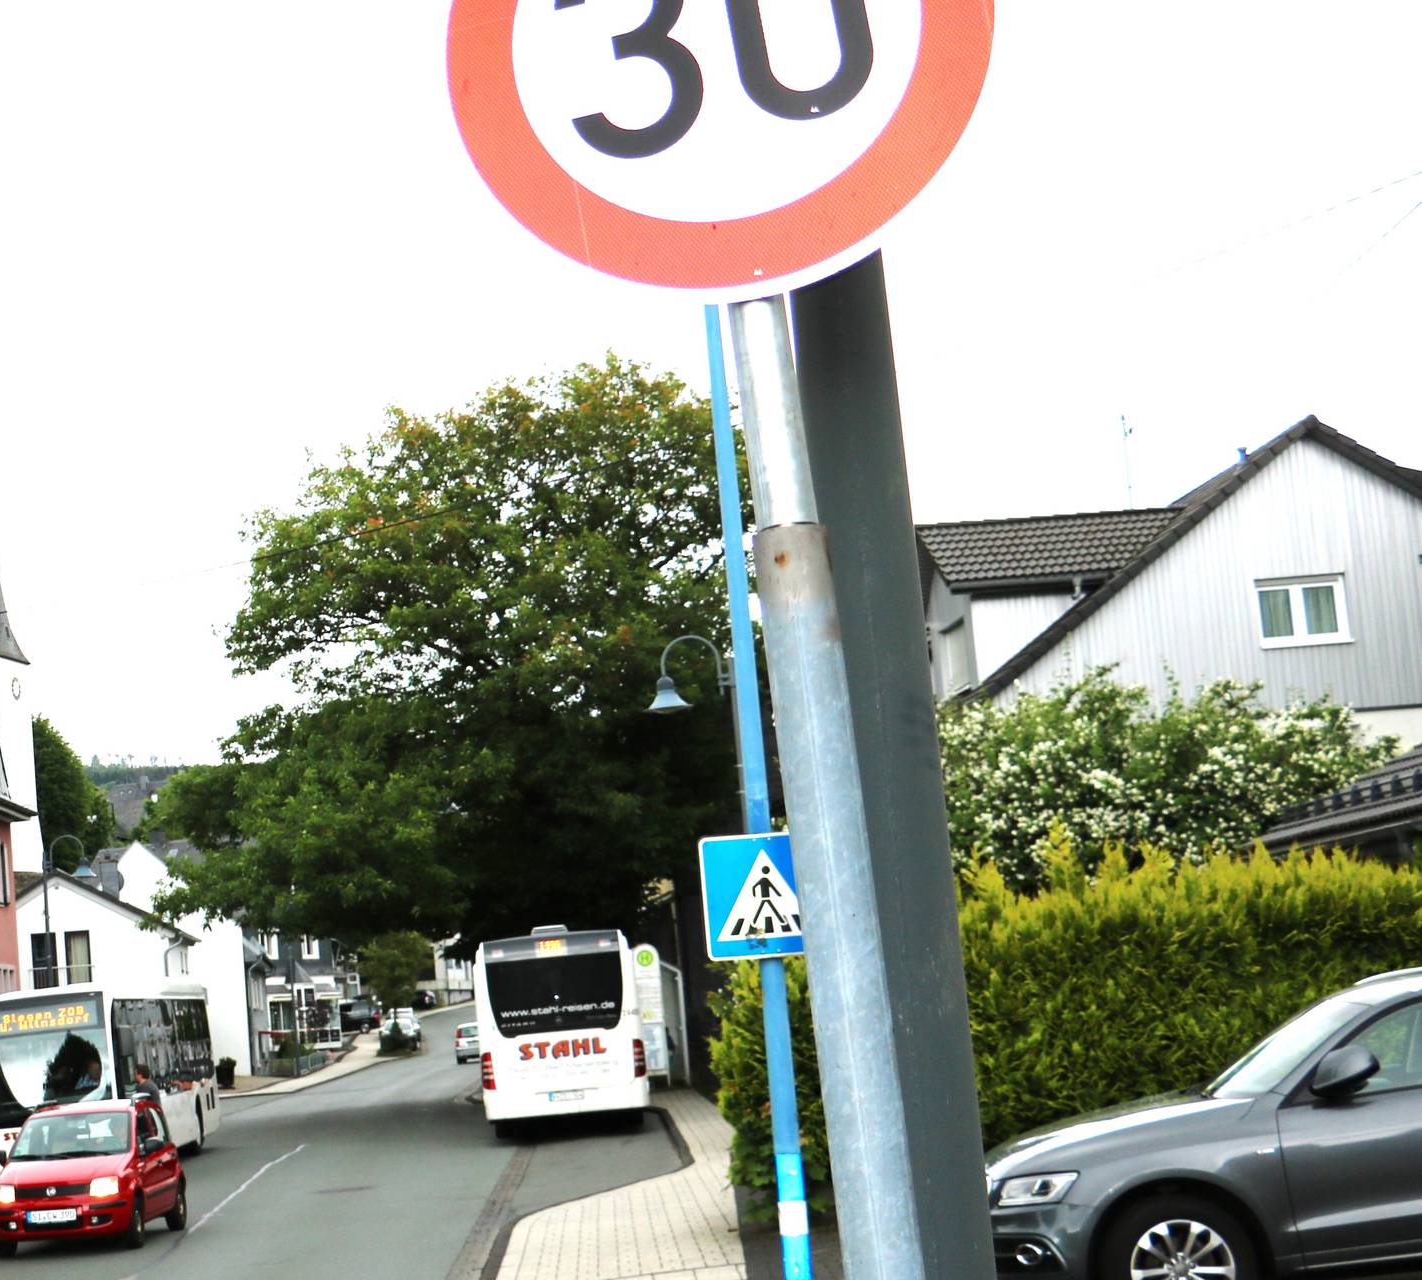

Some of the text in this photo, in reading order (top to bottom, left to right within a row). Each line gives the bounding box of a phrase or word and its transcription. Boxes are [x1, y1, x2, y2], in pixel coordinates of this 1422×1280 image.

[556, 0, 874, 159] 30
[500, 1000, 616, 1018] www.stahl-reisen.de
[519, 1037, 607, 1061] STAHL
